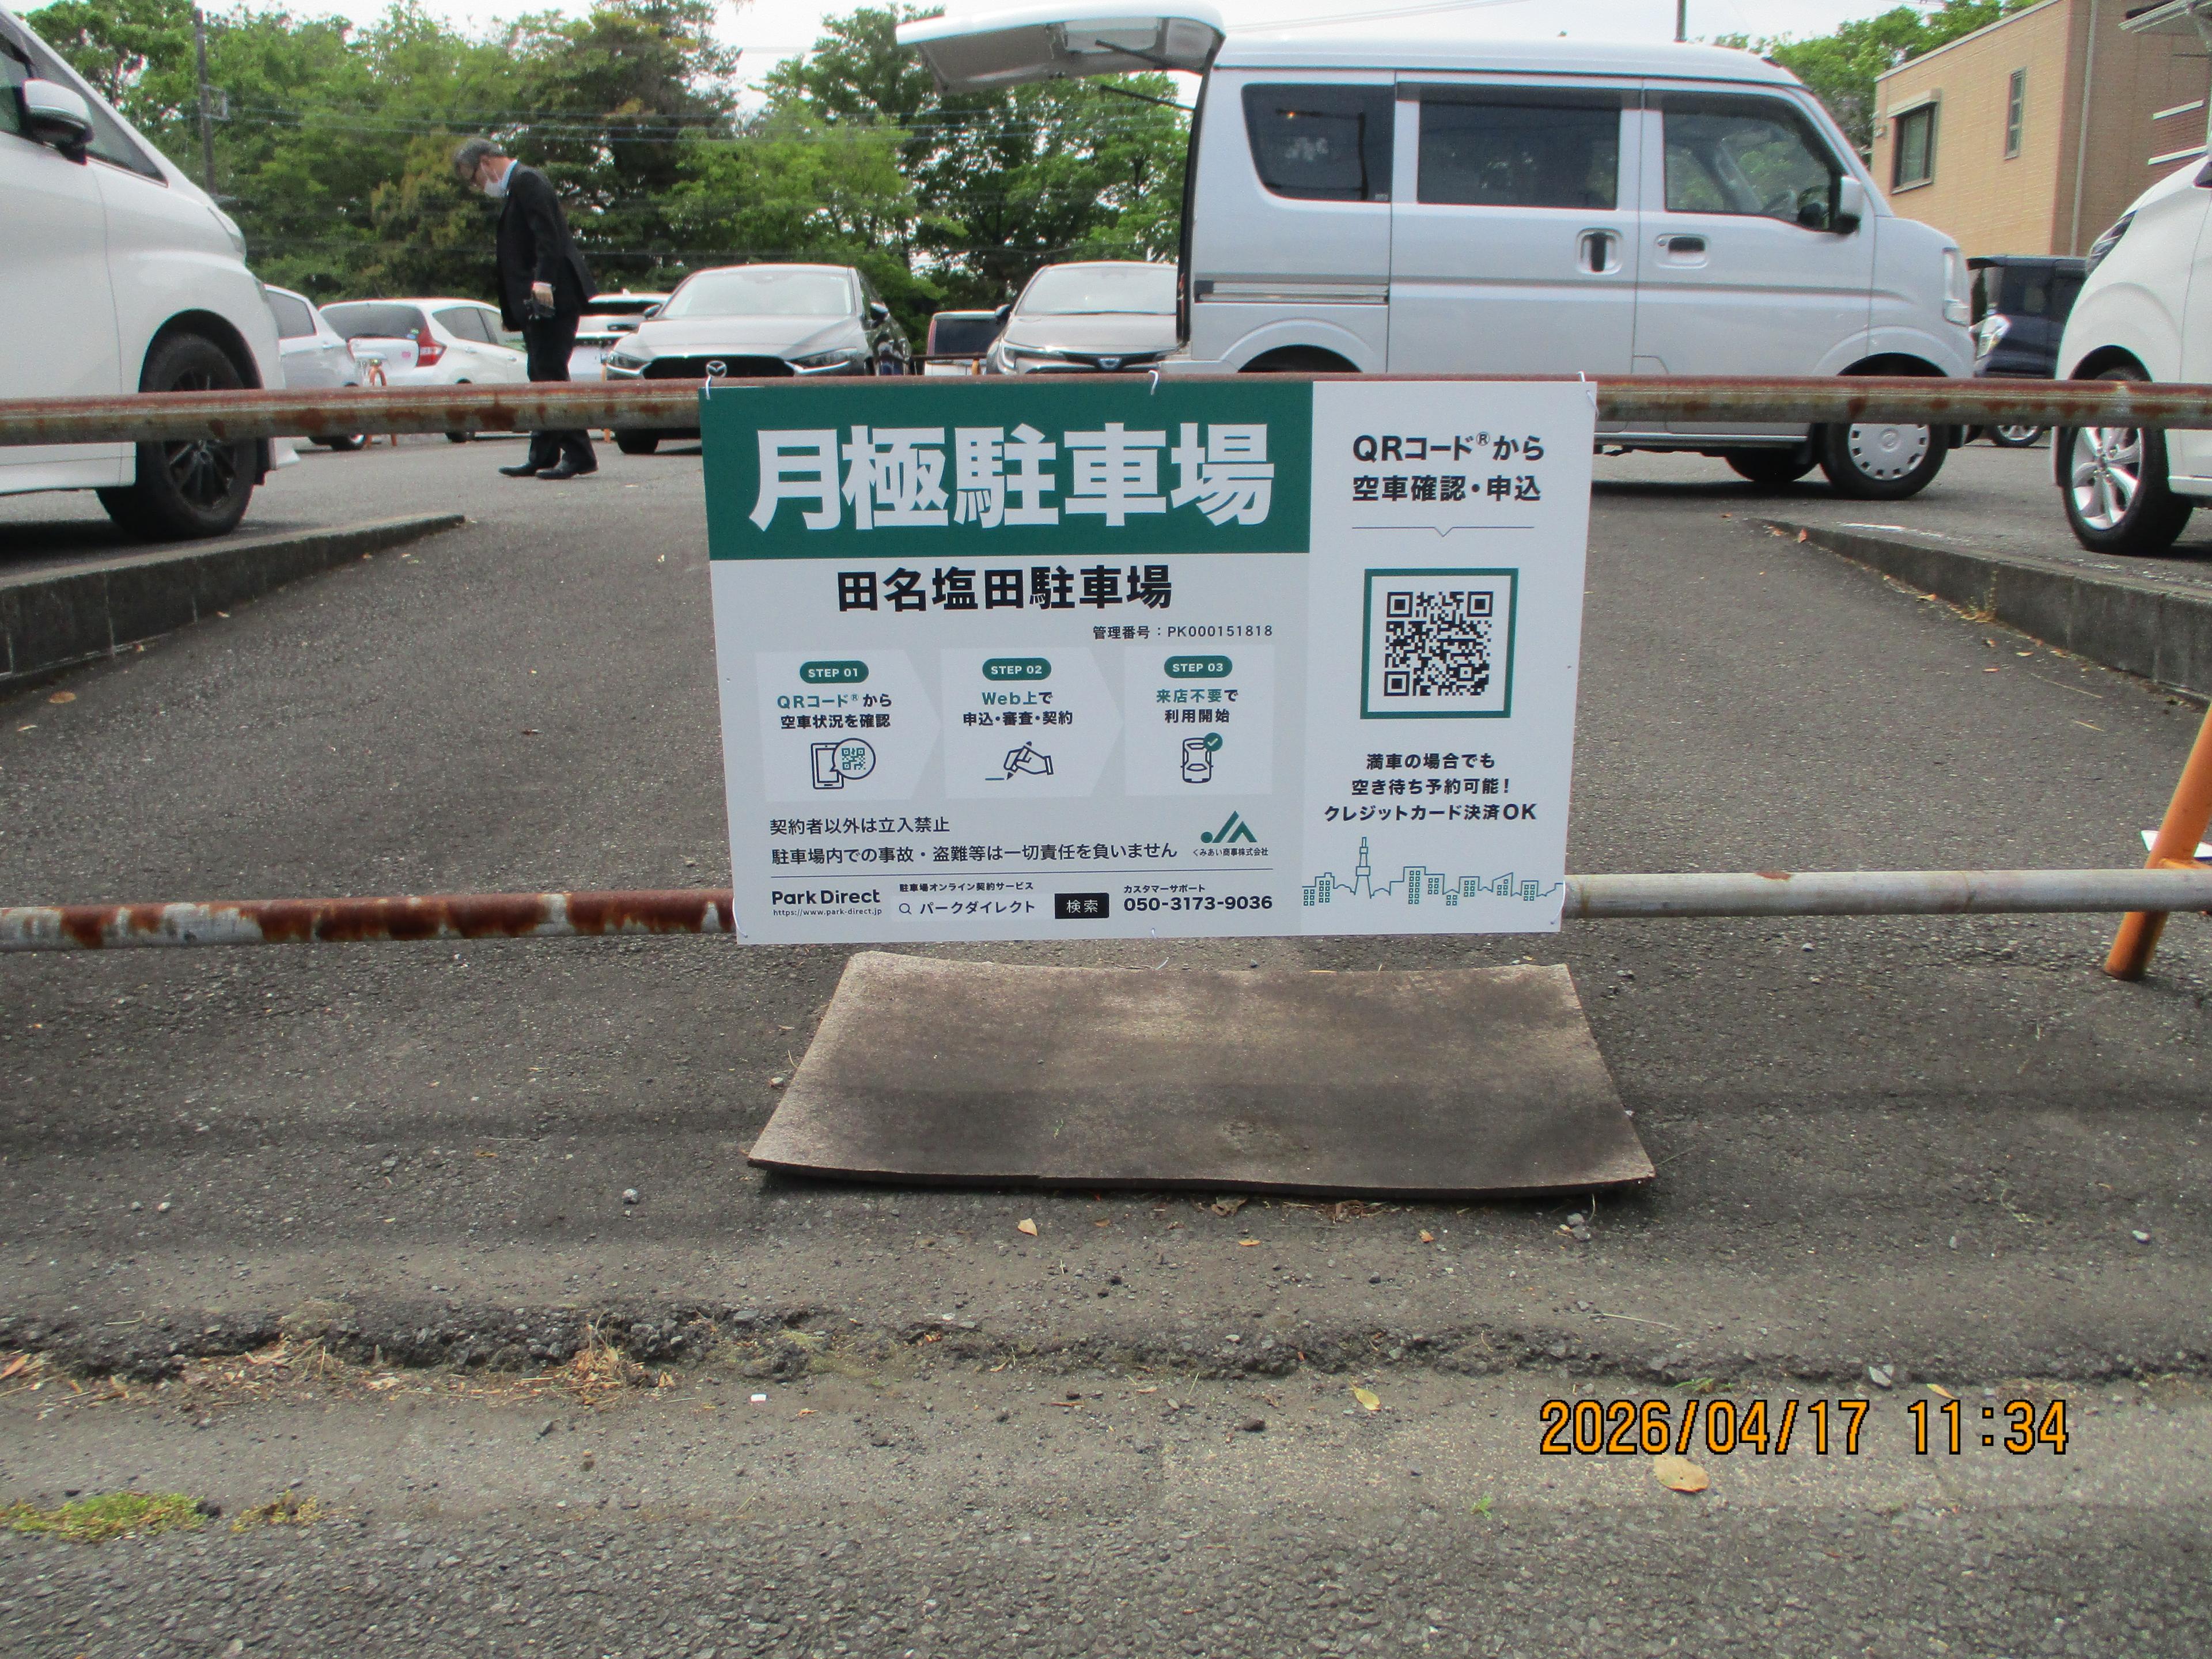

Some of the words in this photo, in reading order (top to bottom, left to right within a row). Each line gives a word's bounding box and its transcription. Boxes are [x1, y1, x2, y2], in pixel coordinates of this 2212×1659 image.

[748, 422, 1275, 532] 月極駐車場
[837, 565, 1172, 612] 田名塩田駐車場
[808, 668, 840, 678] STEP
[843, 668, 858, 677] 01
[991, 665, 1022, 675] STEP
[1026, 665, 1042, 675] 02
[1172, 663, 1203, 672] STEP
[1207, 662, 1224, 672] 03
[982, 691, 1054, 706] Web上で
[1156, 688, 1238, 704] 来店不要で
[781, 713, 891, 730] 空車状況を確認
[1164, 708, 1230, 724] 利用開始
[1366, 752, 1495, 770] 満車の場合でも
[1324, 803, 1537, 822] クレジットカード決済OK
[770, 816, 950, 836] 契約者以外は立入禁止
[1193, 847, 1268, 857] くみあい商事株式会社
[899, 881, 1033, 892] 駐車場オンライン契約サービス
[1124, 884, 1206, 894] カスタマーサポート
[772, 890, 817, 906] Park
[820, 889, 881, 904] Direct
[1123, 895, 1272, 911] 050-3173-9036
[773, 907, 882, 917] https://www.park-direct.jp
[919, 900, 1035, 915] パークダイレクト
[1066, 899, 1098, 914] 検索
